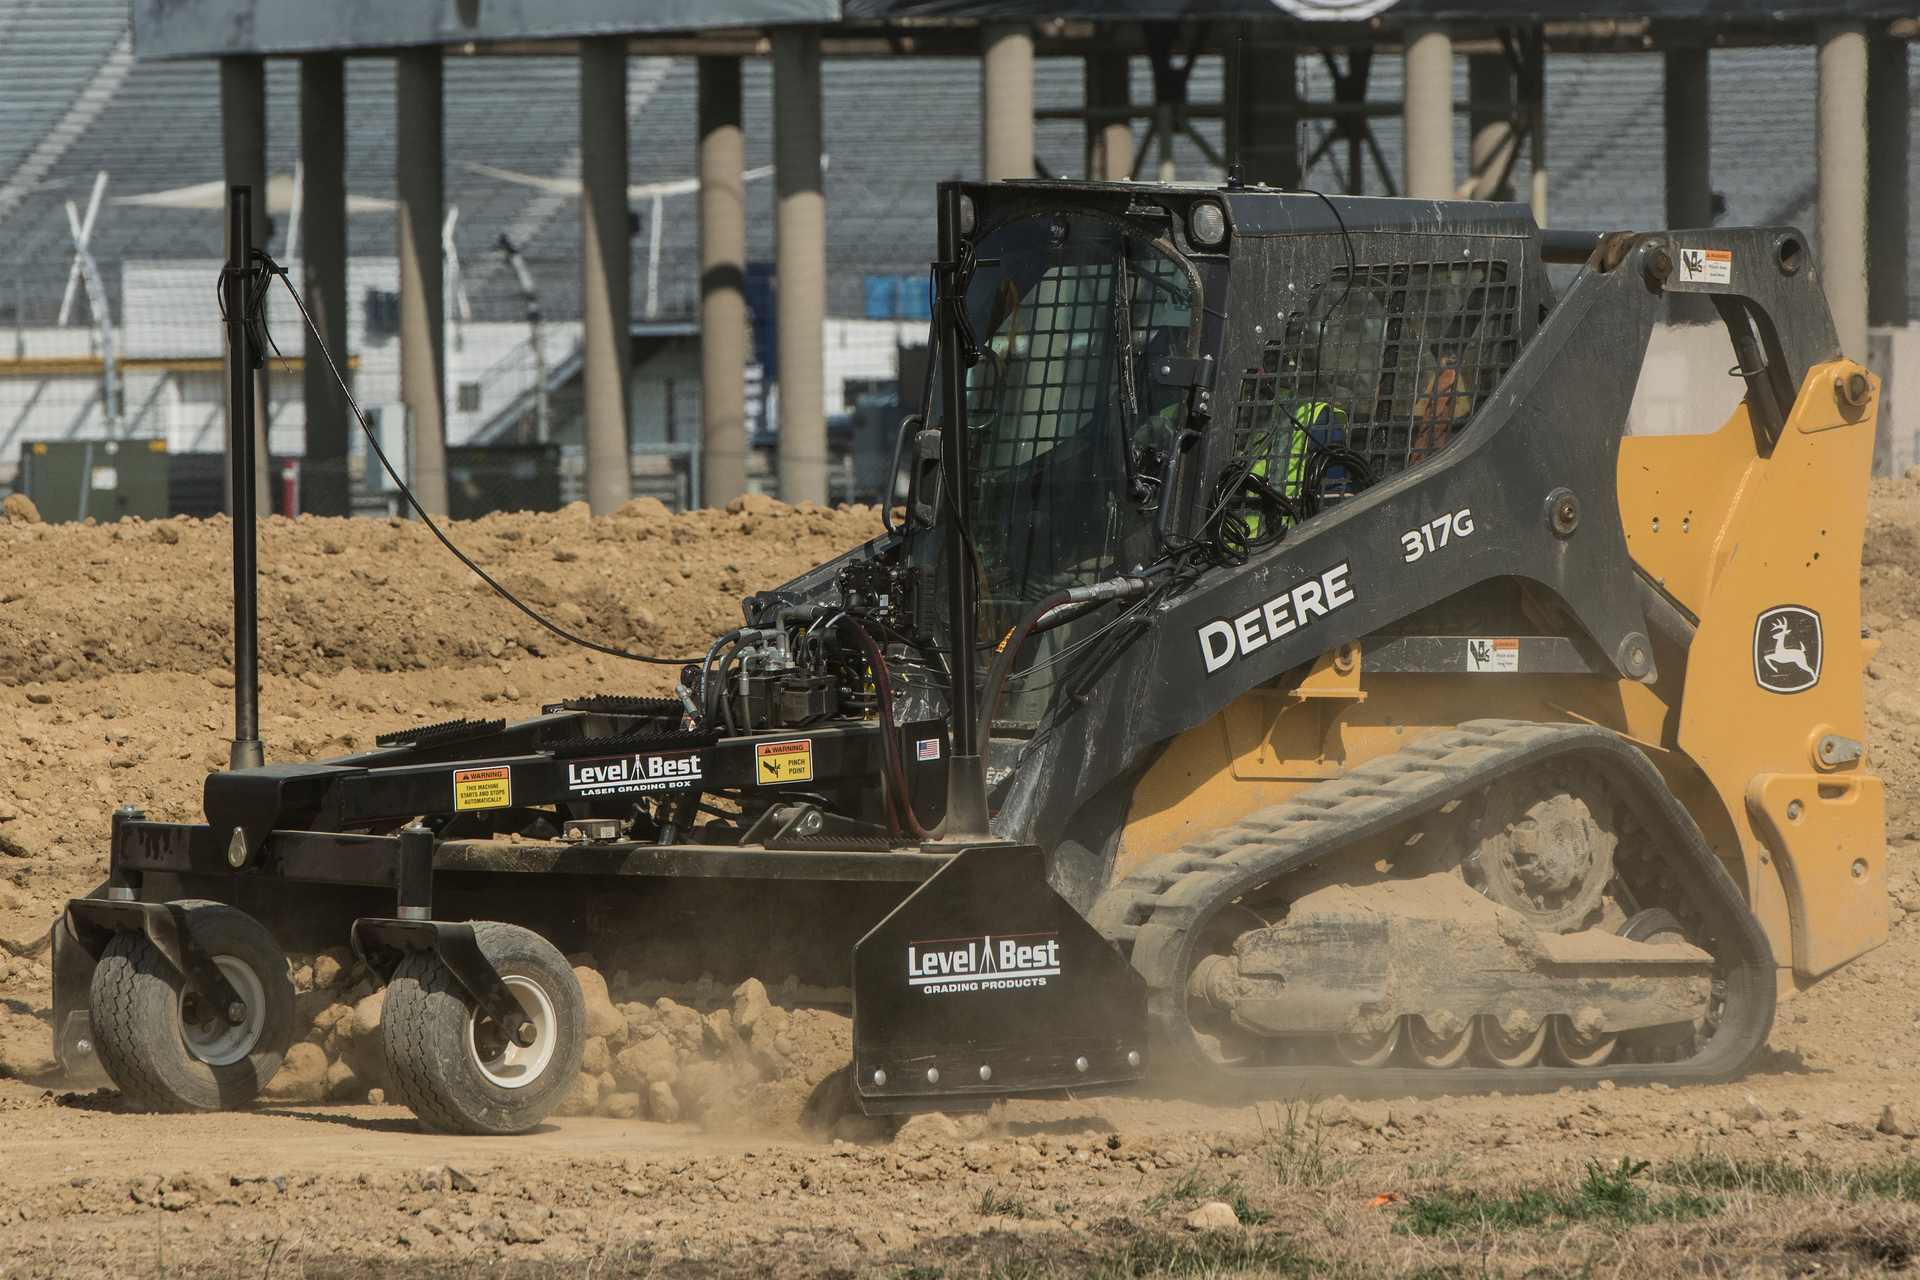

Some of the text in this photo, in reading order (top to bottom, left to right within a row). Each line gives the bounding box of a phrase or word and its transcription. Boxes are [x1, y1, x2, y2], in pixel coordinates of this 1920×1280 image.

[1401, 508, 1475, 563] 317G
[1199, 563, 1354, 674] DEERE
[772, 745, 803, 753] WARNING
[471, 771, 502, 779] WARNING
[569, 755, 702, 784] Level Best
[581, 788, 615, 796] LASER
[618, 782, 666, 793] GRADING
[464, 797, 502, 805] AUTOMATICALLY
[909, 940, 1060, 976] Level Best
[923, 977, 1047, 994] GRADING PRODUCTS
